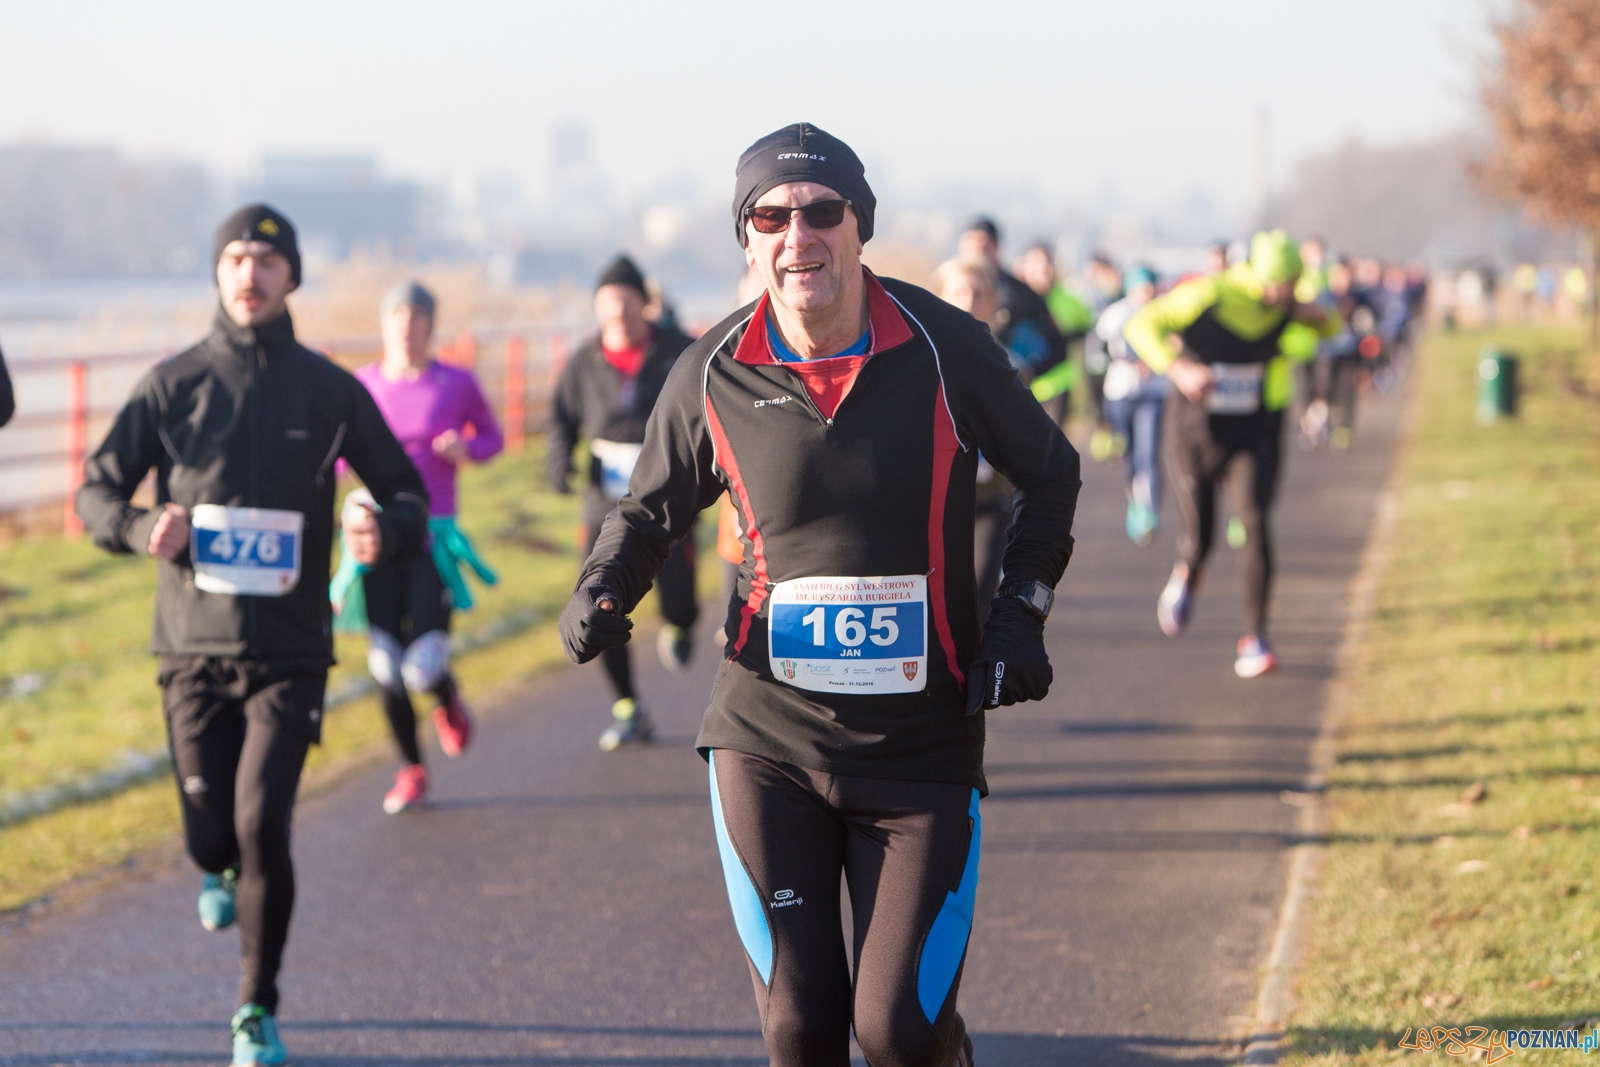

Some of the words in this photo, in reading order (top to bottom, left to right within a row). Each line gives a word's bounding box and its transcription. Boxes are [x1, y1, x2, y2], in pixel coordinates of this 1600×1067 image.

[209, 530, 281, 563] 476
[820, 583, 843, 591] BIEG
[845, 581, 915, 591] SYLWESTROWY
[795, 593, 810, 601] IM.
[812, 593, 863, 602] RYSZARDA
[865, 592, 911, 601] BURGIELA
[802, 606, 899, 647] 165
[840, 648, 861, 657] JAN
[770, 897, 803, 909] Kalenji
